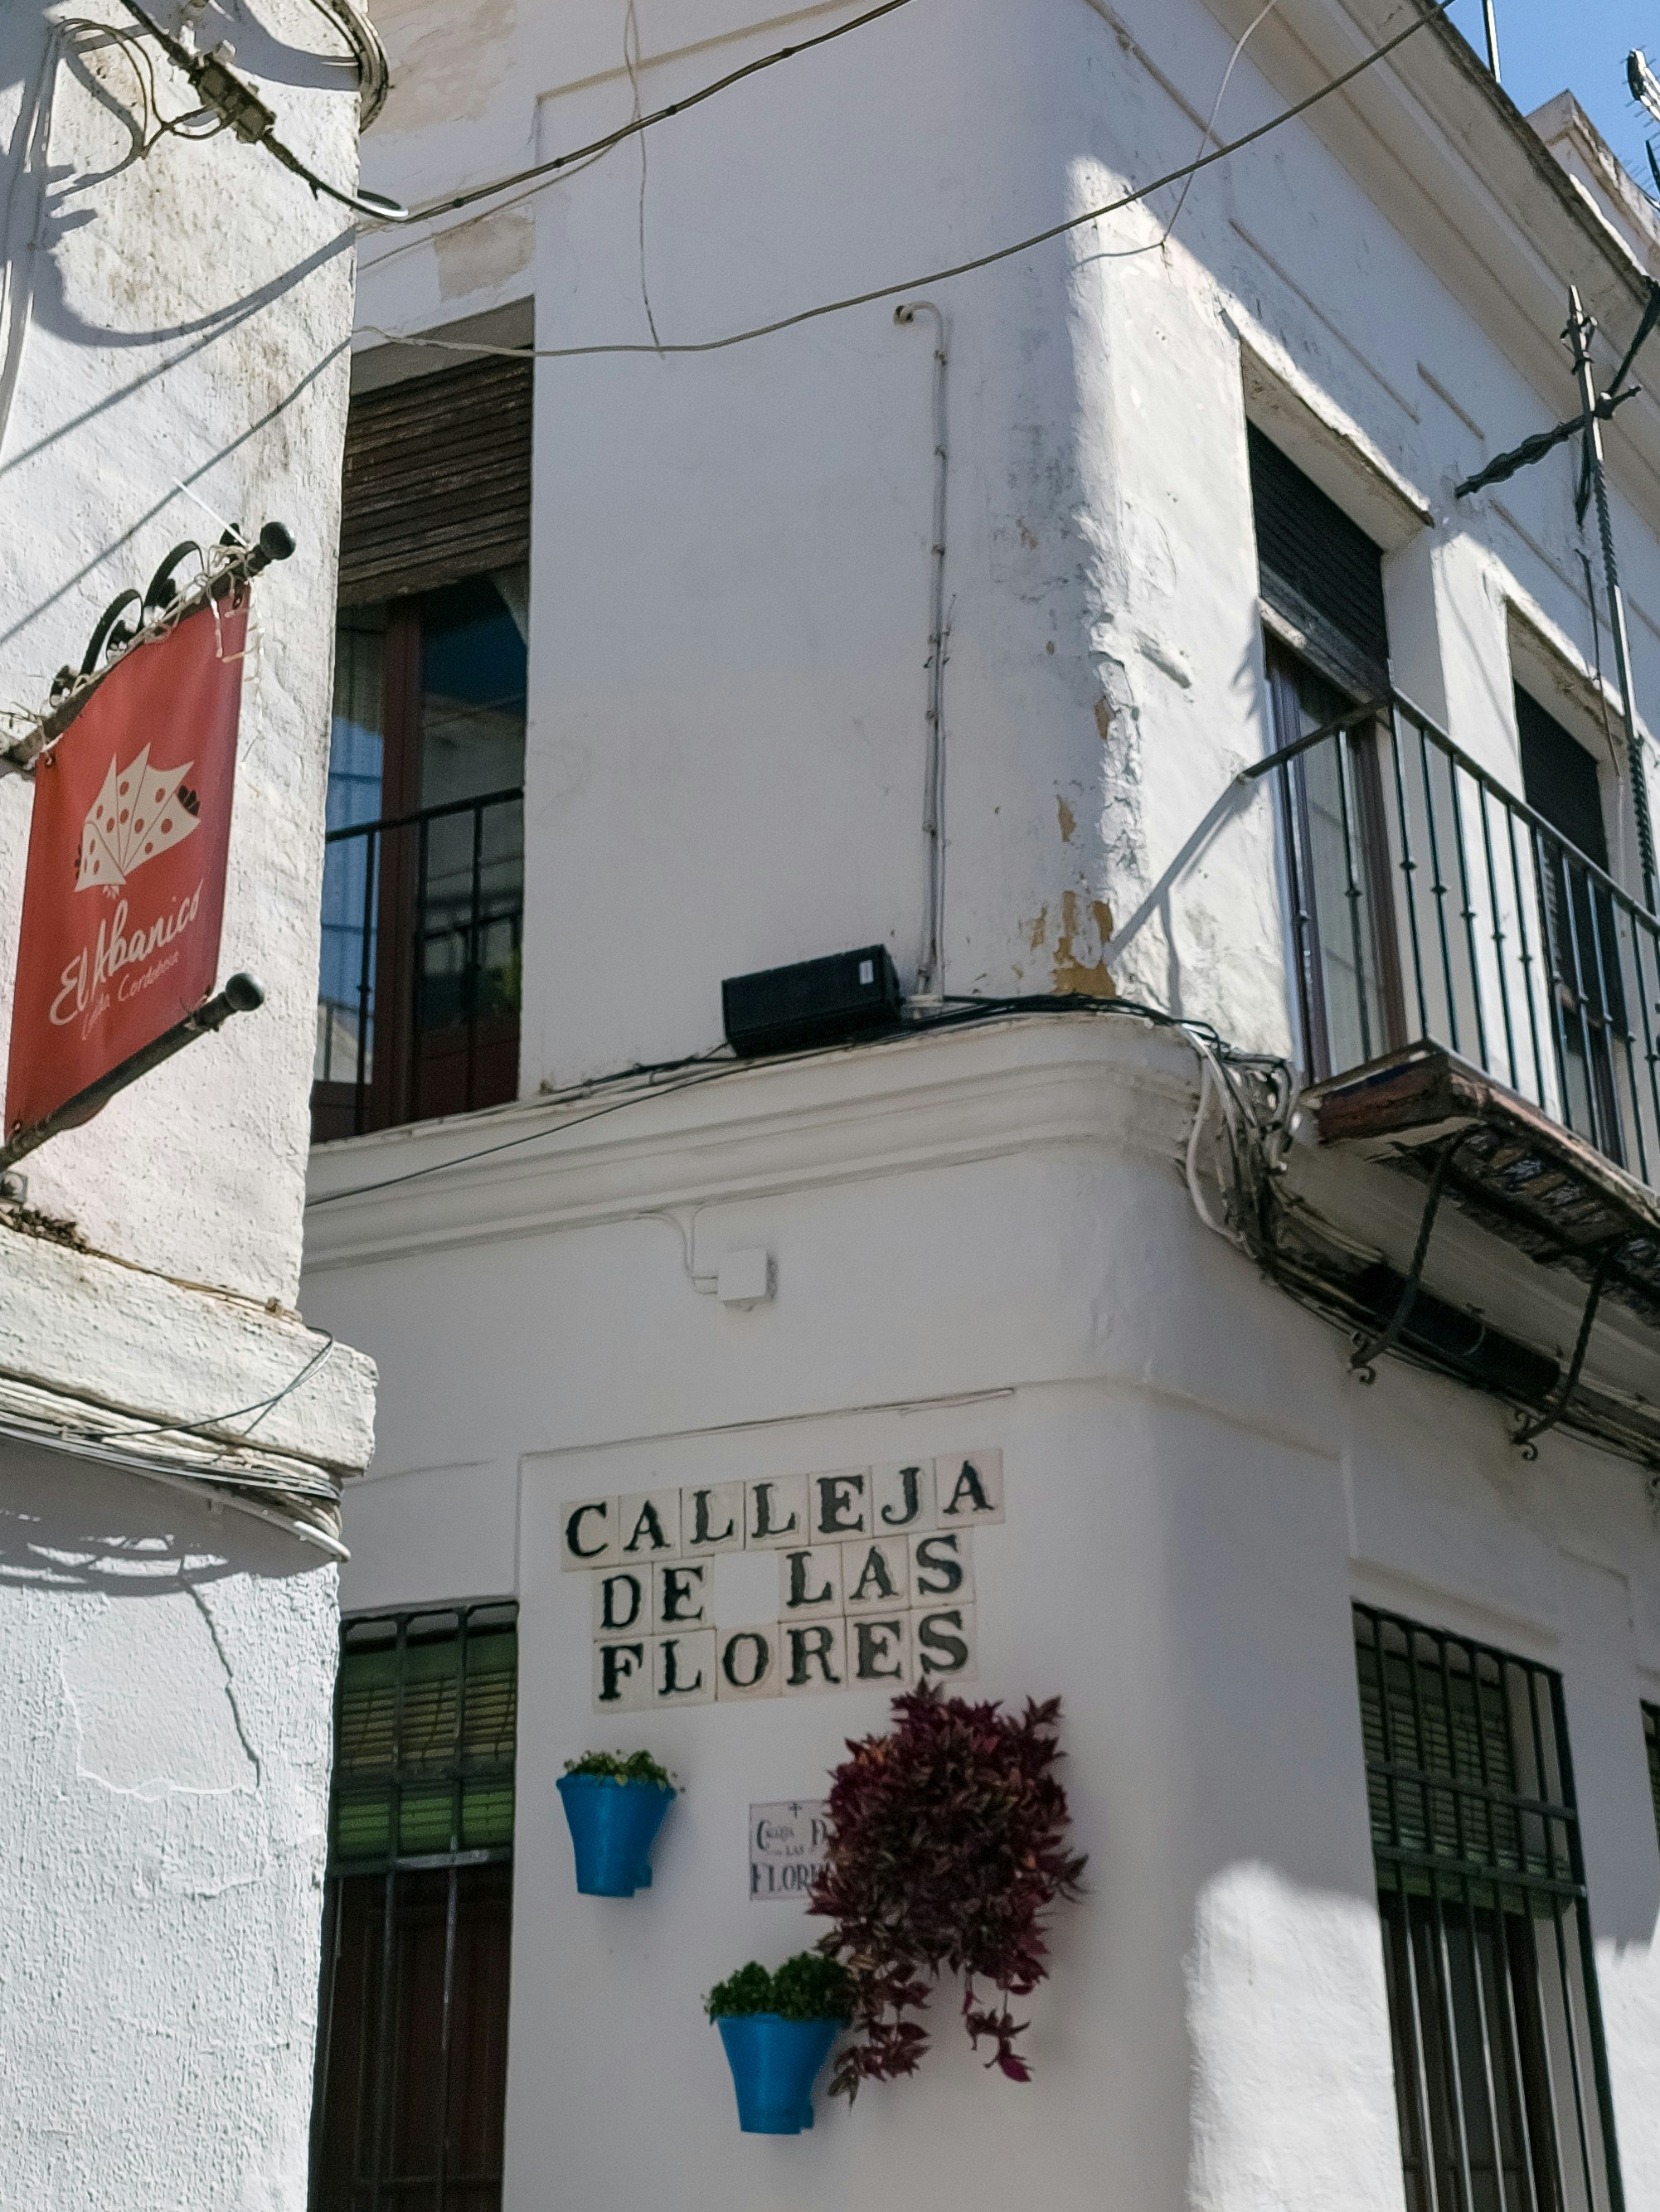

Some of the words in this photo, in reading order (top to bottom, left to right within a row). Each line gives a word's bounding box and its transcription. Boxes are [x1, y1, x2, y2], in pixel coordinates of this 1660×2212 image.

[50, 946, 88, 1026] El
[91, 878, 204, 1003] Abanico
[565, 1459, 995, 1558] CALLEJA
[599, 1566, 704, 1631] DE
[786, 1534, 963, 1608] LAS
[598, 1610, 968, 1702] FLORES
